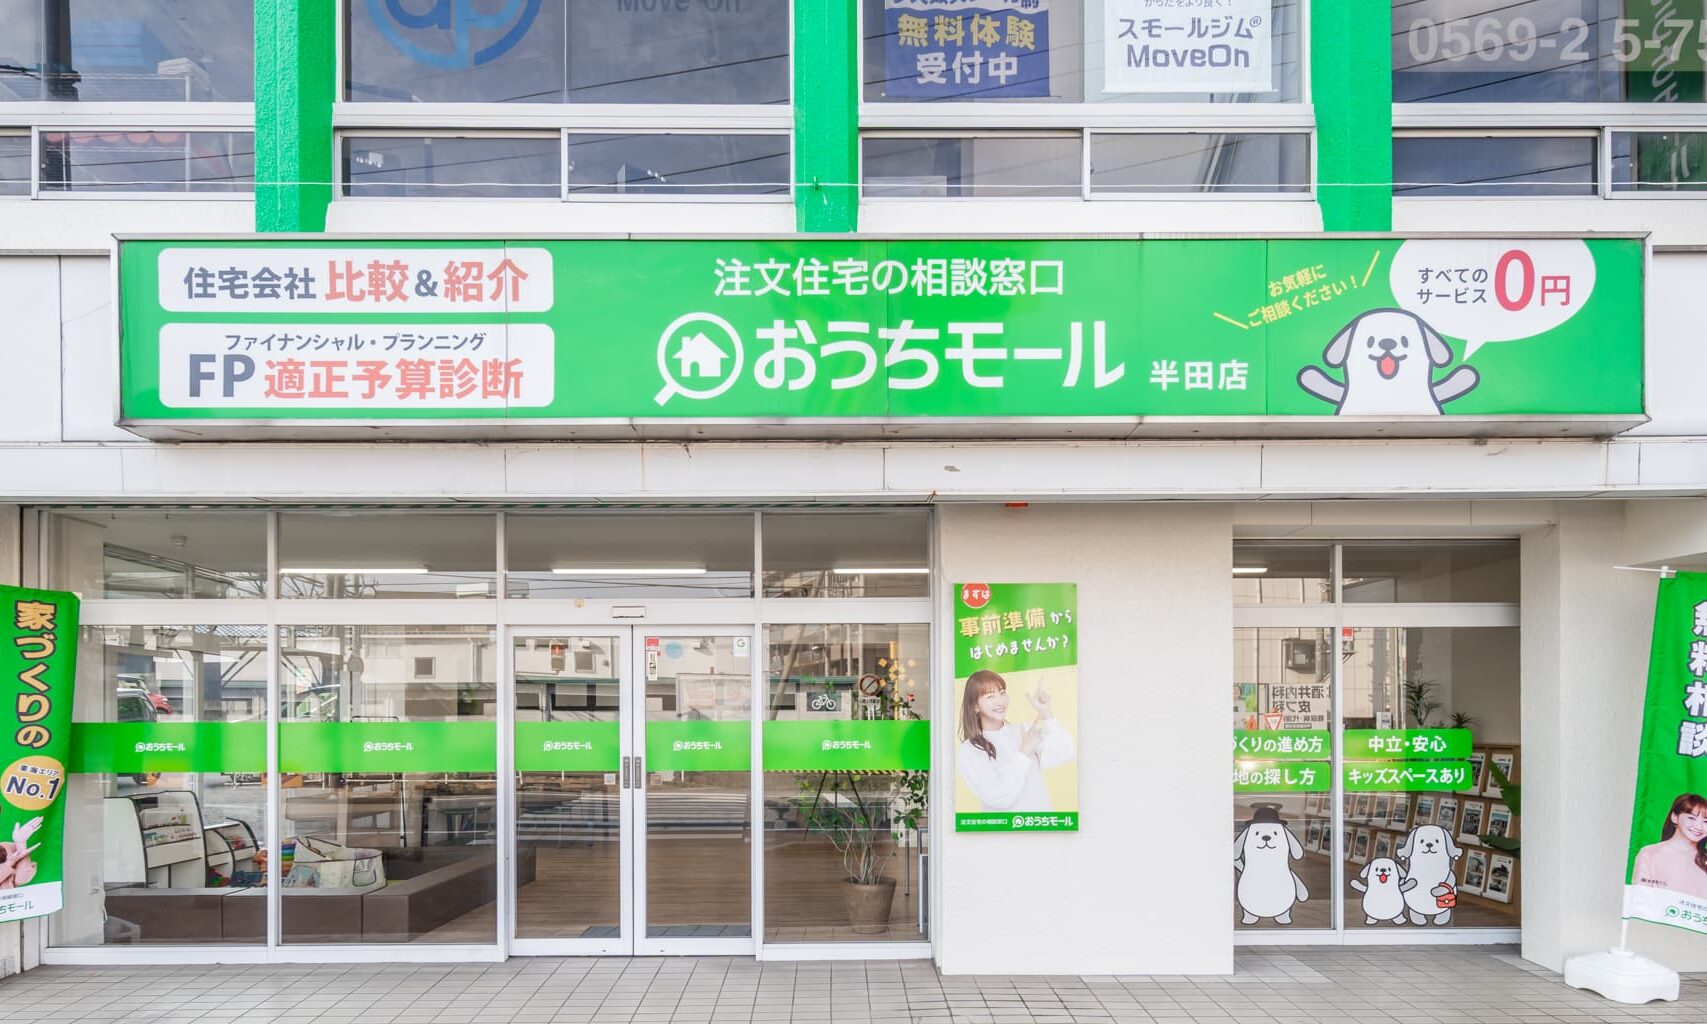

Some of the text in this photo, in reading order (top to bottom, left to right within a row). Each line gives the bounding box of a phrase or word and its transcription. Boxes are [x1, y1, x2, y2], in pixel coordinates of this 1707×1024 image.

[897, 13, 1036, 50] 無料体験
[916, 51, 1018, 84] 受付中
[1127, 44, 1250, 68] MoveOn
[183, 266, 316, 300] 住宅会社
[713, 258, 1065, 297] 注文住宅の相談窓口
[1266, 263, 1327, 298] お気軽に
[1417, 267, 1489, 284] すべての
[1493, 249, 1571, 312] 0円
[1416, 288, 1487, 305] サービス
[225, 332, 487, 352] ファイナンシャル・プランニング
[753, 318, 1249, 391] おうちモール 半田店
[188, 354, 524, 400] FP 適正予算診断
[962, 589, 990, 600] まずは
[958, 608, 1073, 638] 事前準備から
[970, 634, 1070, 660] はじめませんか?
[14, 599, 58, 750] 家づくりの
[146, 742, 186, 752] おうちモール
[373, 742, 414, 752] おうちモール
[553, 741, 593, 750] おうちモール
[683, 741, 723, 750] おうちモール
[832, 740, 872, 750] おうちモール
[1368, 736, 1447, 753] 中立・安心
[6, 775, 60, 799] No.1
[1349, 767, 1465, 784] キッズスペースあり
[1024, 816, 1074, 827] おうちモール
